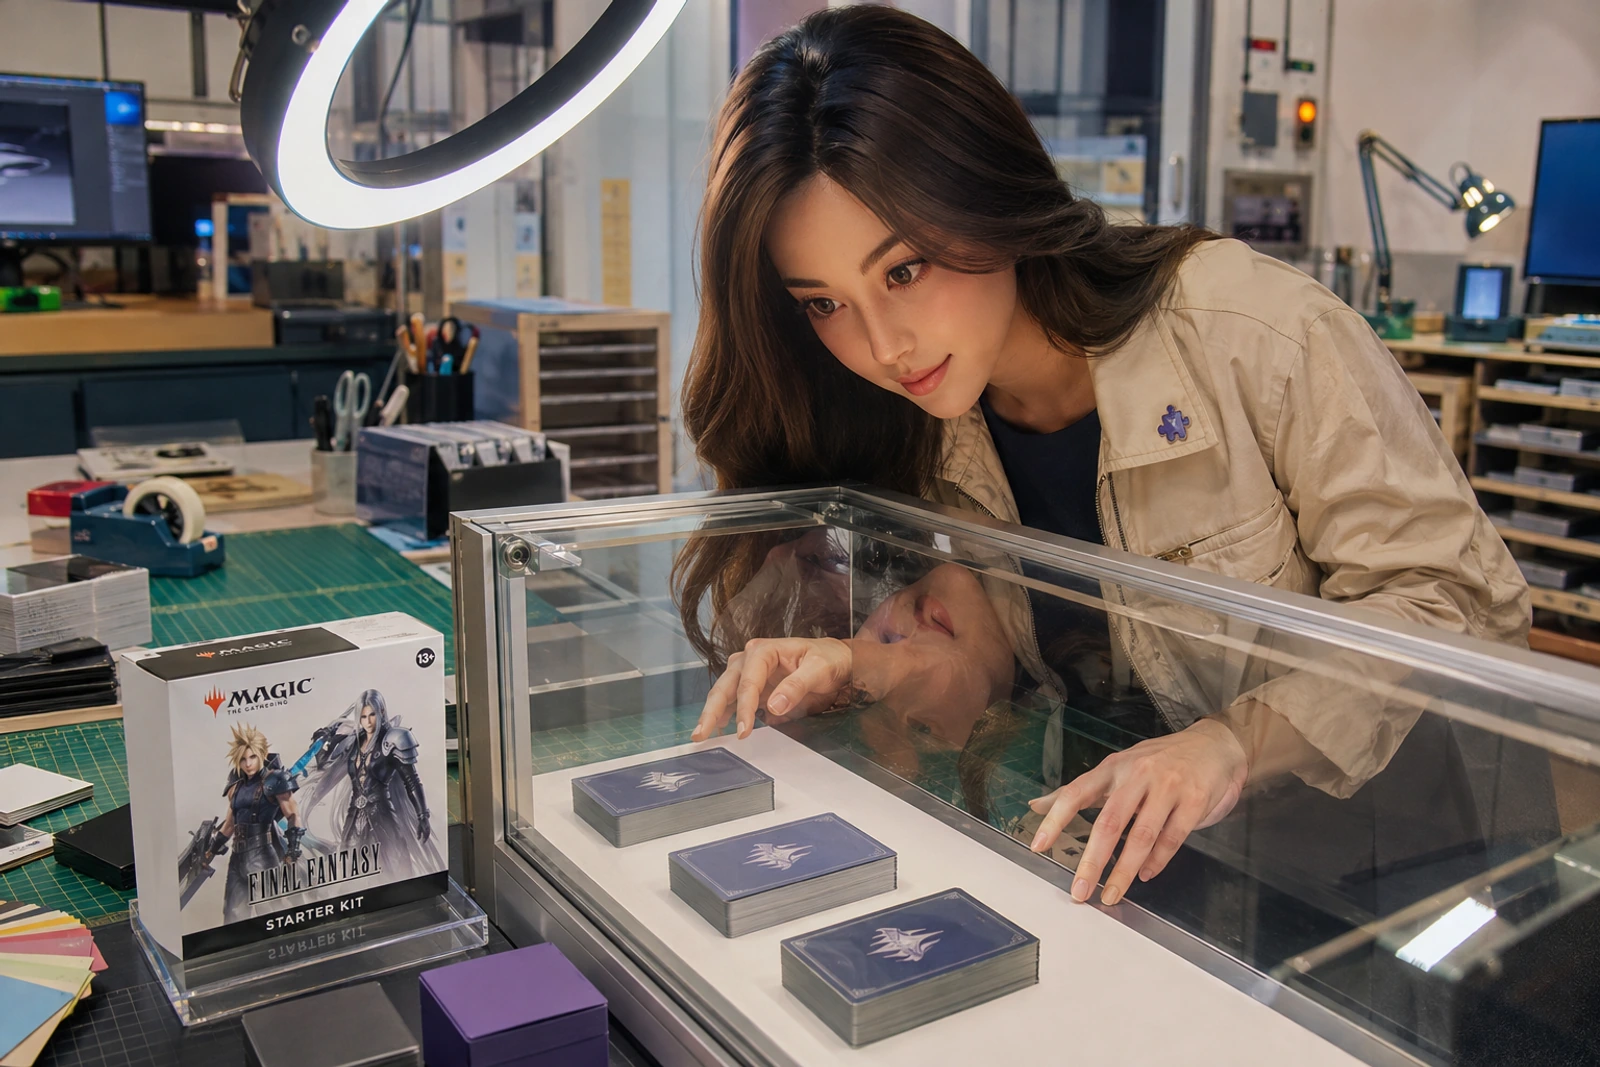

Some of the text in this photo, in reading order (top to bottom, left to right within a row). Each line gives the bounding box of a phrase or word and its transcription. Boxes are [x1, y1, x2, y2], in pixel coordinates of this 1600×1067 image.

[417, 652, 435, 664] 13+
[227, 678, 312, 708] MAGIC
[249, 843, 380, 901] FINAL FANTASY
[266, 896, 364, 931] STARTER KIT
